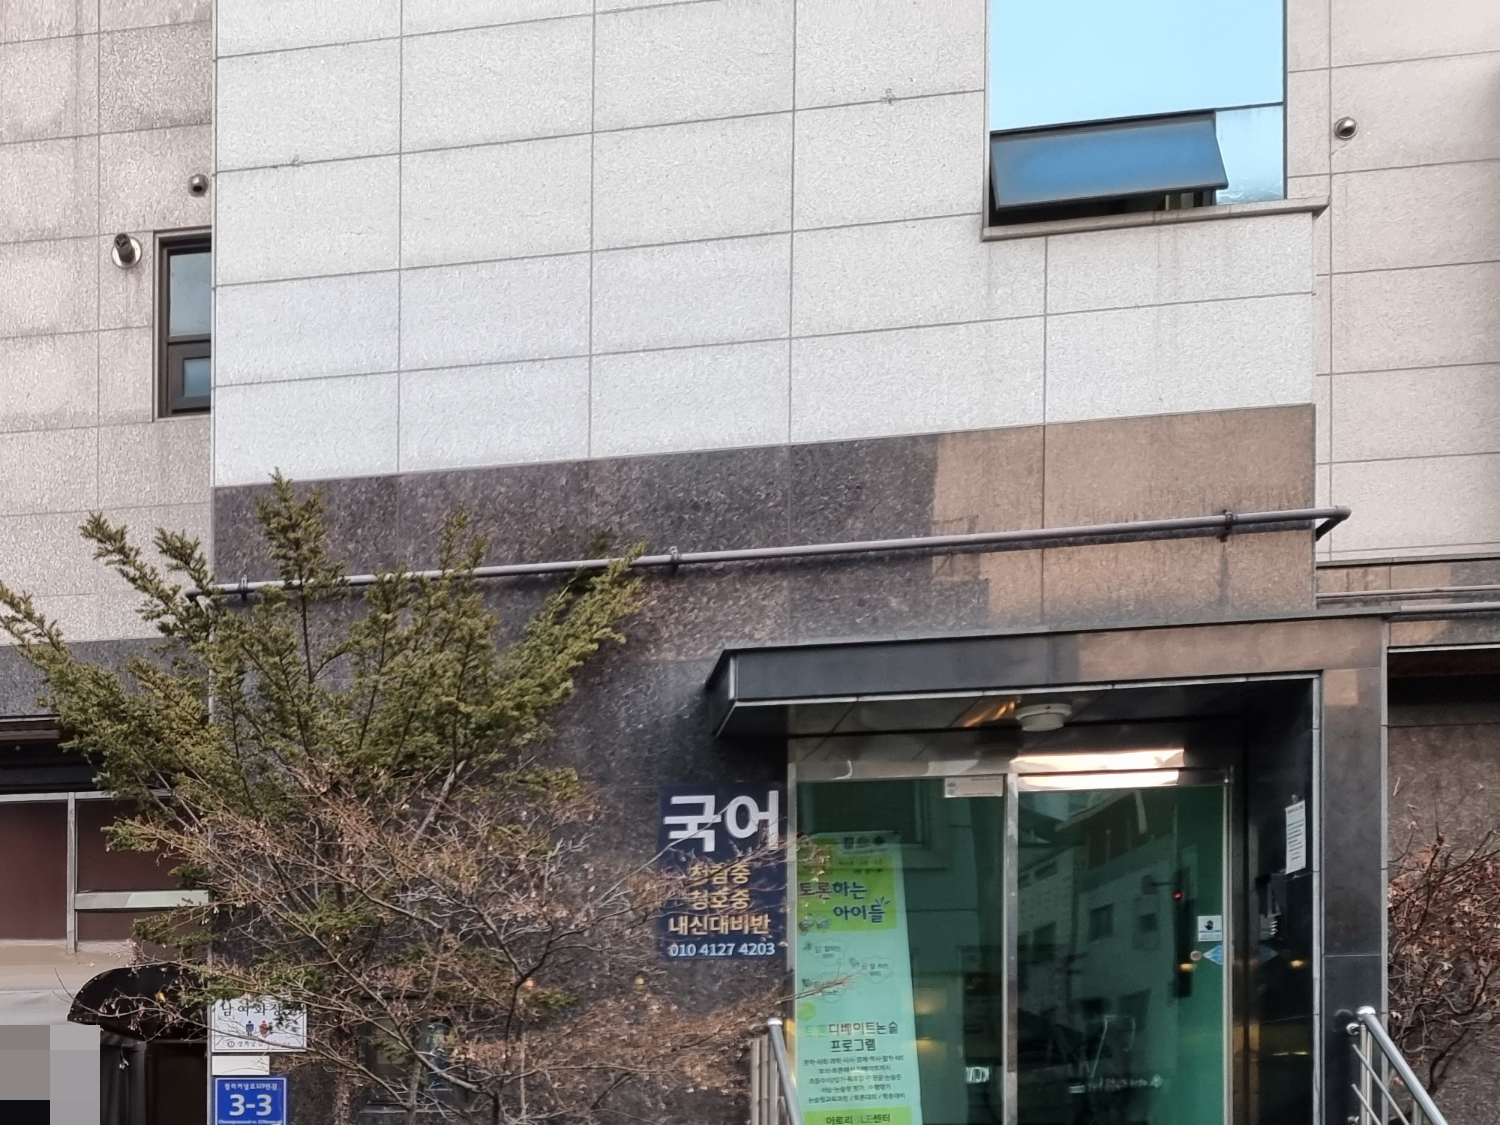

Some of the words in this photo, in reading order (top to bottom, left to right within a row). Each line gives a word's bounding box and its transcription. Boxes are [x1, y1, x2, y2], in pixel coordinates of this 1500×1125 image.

[663, 790, 779, 852] 국어
[690, 888, 750, 910] 청호중
[800, 881, 867, 900] 토론하는
[833, 904, 886, 923] 아이들
[668, 913, 771, 936] 내신대비반
[668, 943, 697, 957] 010
[699, 943, 735, 956] 4127
[738, 942, 775, 956] 4203
[830, 1038, 876, 1052] 프로그램
[229, 1094, 272, 1116] 3-3
[826, 1115, 853, 1125] 아로리
